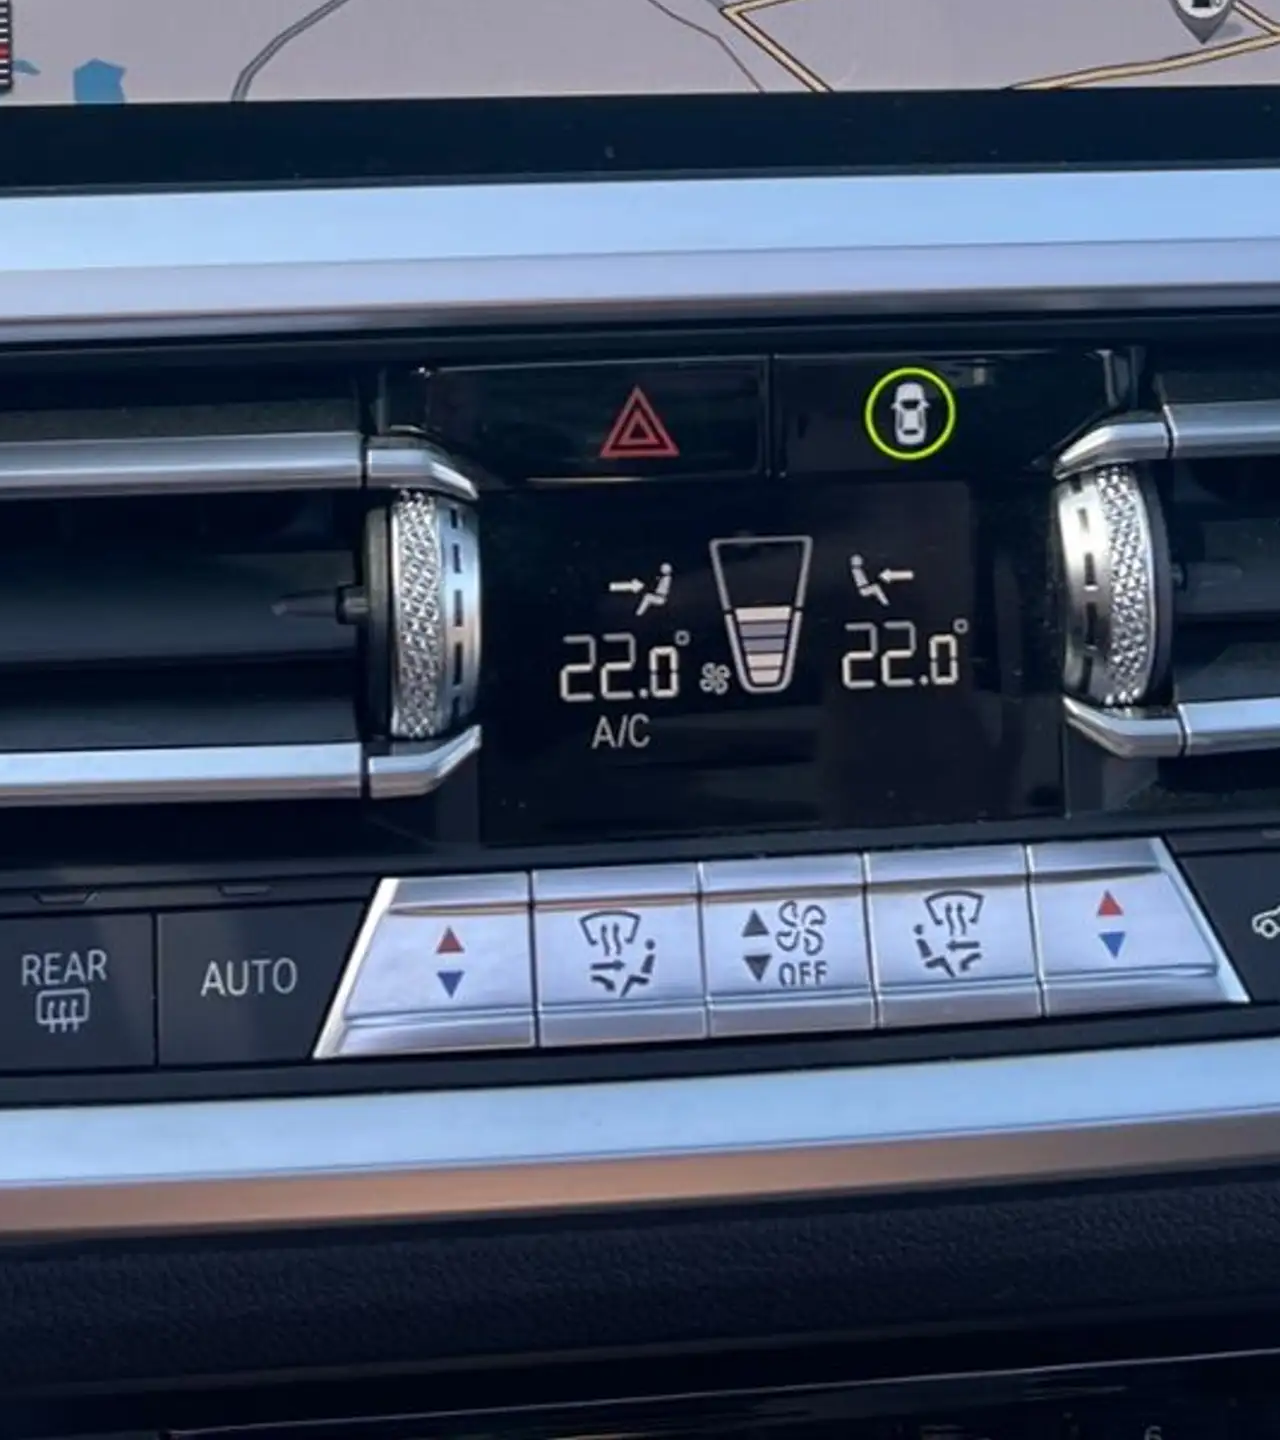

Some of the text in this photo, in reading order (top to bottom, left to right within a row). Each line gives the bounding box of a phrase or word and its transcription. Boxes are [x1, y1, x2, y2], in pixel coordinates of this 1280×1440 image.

[592, 713, 651, 749] A/C
[21, 949, 107, 987] REAR
[201, 957, 298, 997] AUTO
[778, 959, 828, 989] OFF
